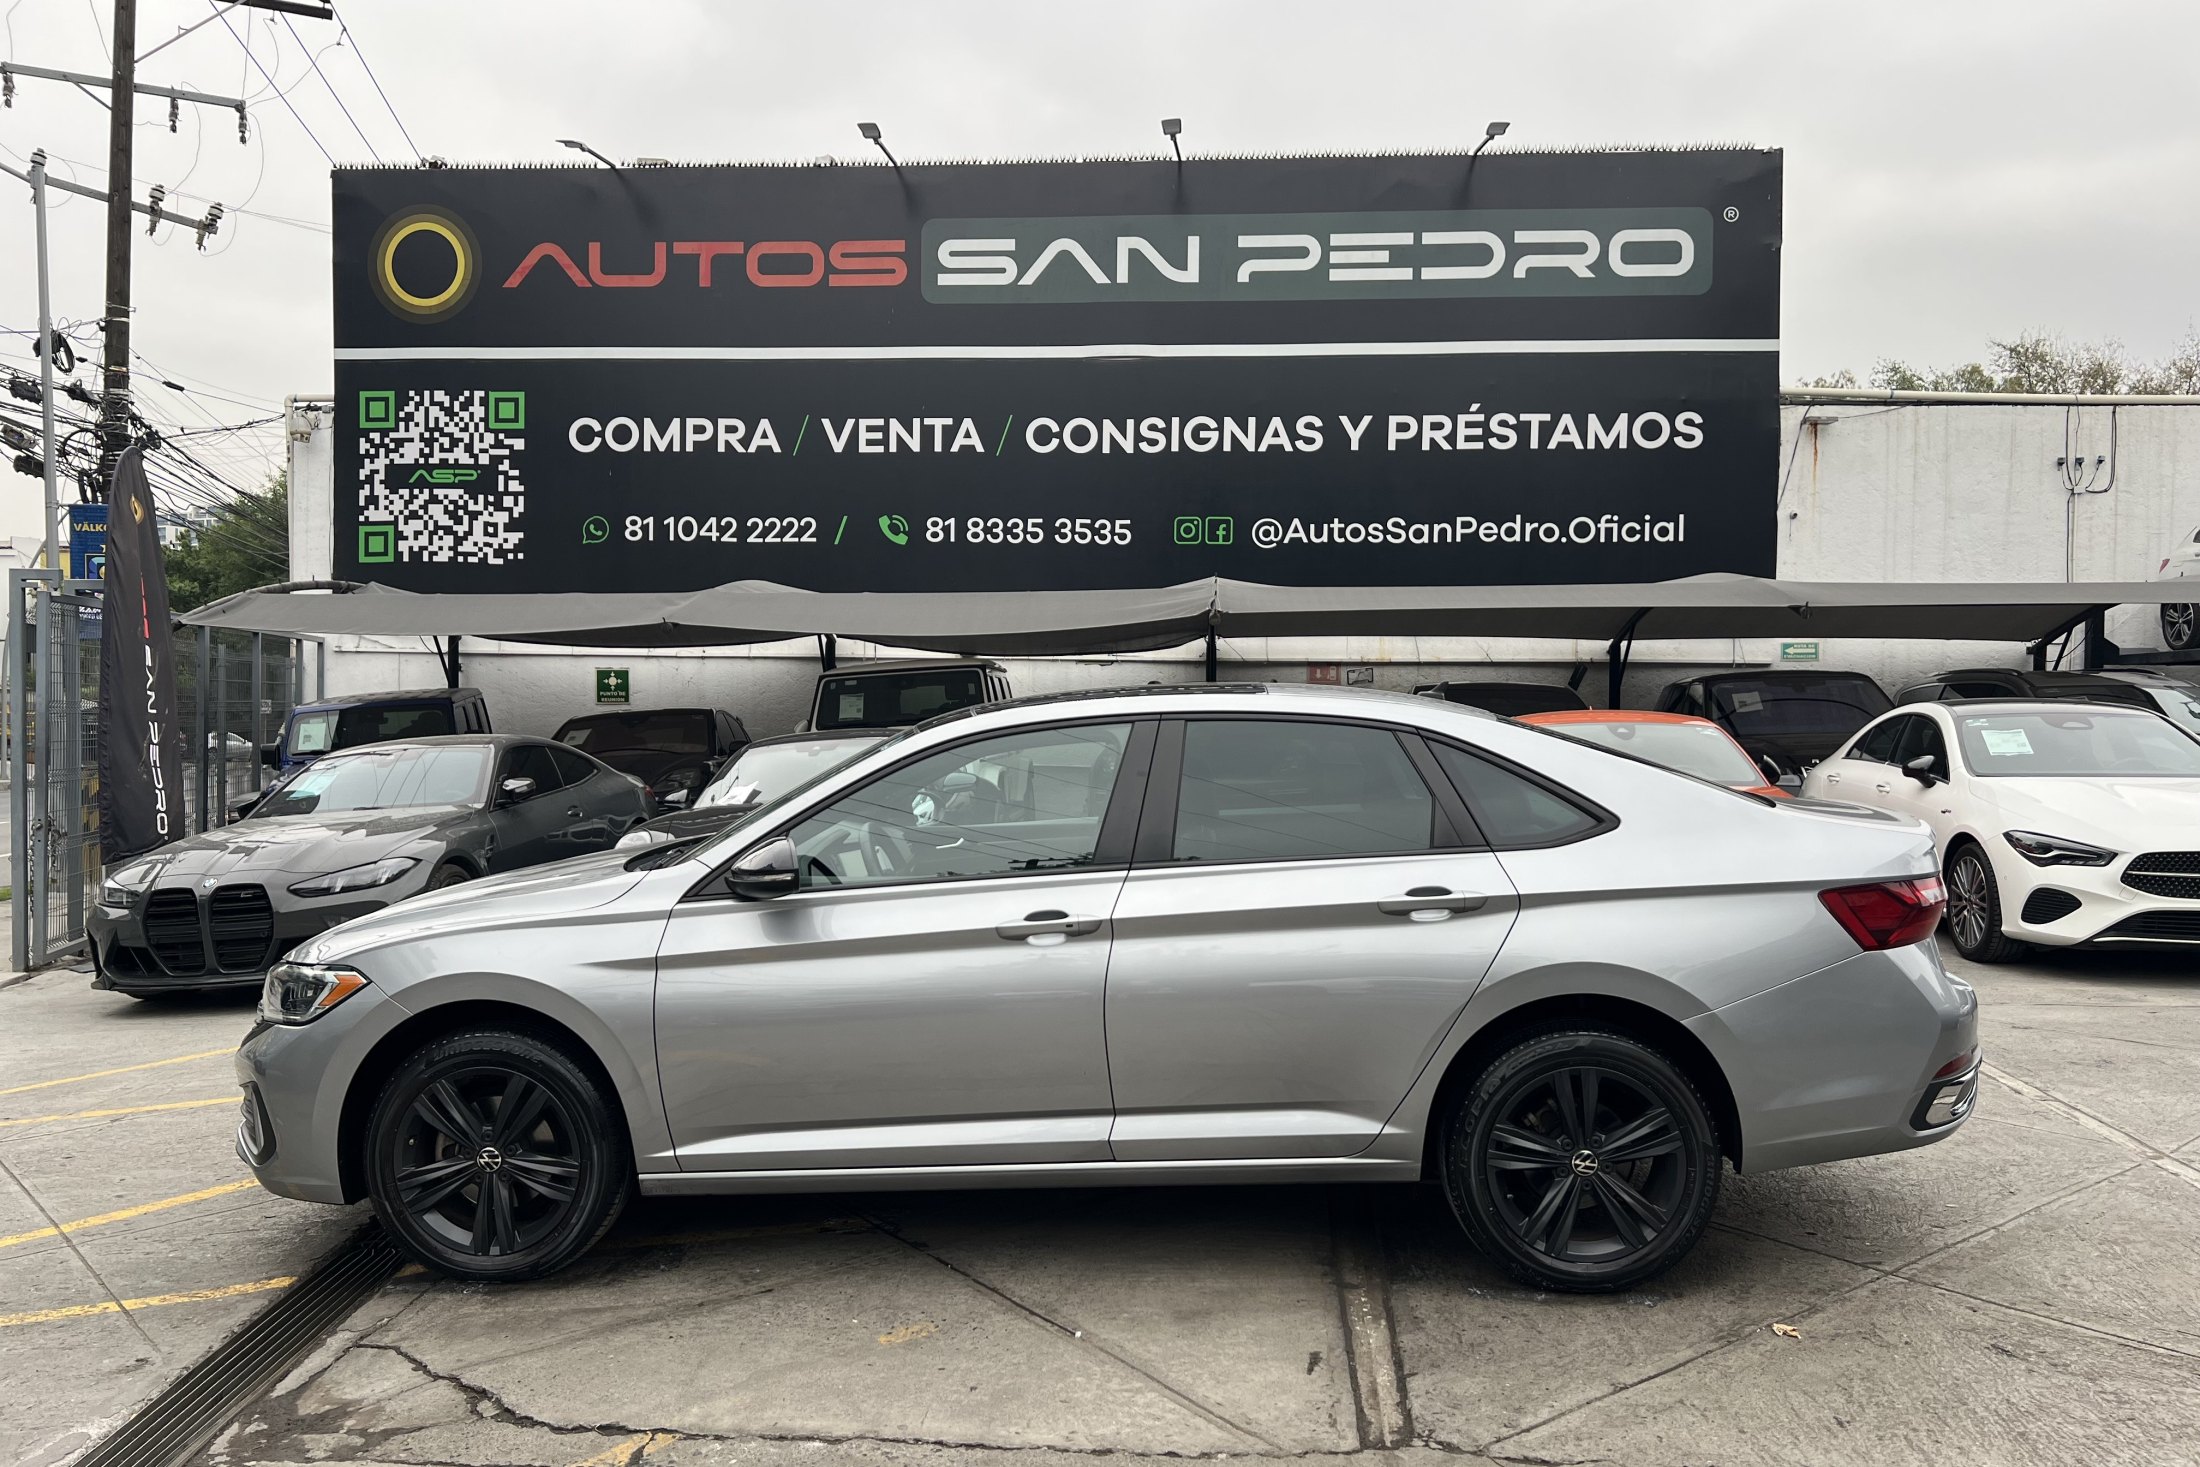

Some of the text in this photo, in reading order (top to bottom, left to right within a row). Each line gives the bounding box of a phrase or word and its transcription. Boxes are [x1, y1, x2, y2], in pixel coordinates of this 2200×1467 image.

[503, 240, 907, 288] AUTOS
[937, 235, 1200, 286] SAN
[1236, 228, 1695, 283] PEDRO
[568, 416, 782, 453] COMPRA
[821, 417, 986, 453] VENTA
[1025, 415, 1324, 454] CONSIGNAS
[1338, 415, 1374, 451] Y
[1387, 403, 1704, 451] PRÉSTAMOS
[408, 469, 478, 483] ASP
[624, 515, 654, 542] 81
[663, 515, 738, 543] 1042
[746, 516, 817, 543] 2222
[925, 516, 1132, 545] 81 8335 3535
[1251, 513, 1685, 549] @AutosSanPedro.Oficial
